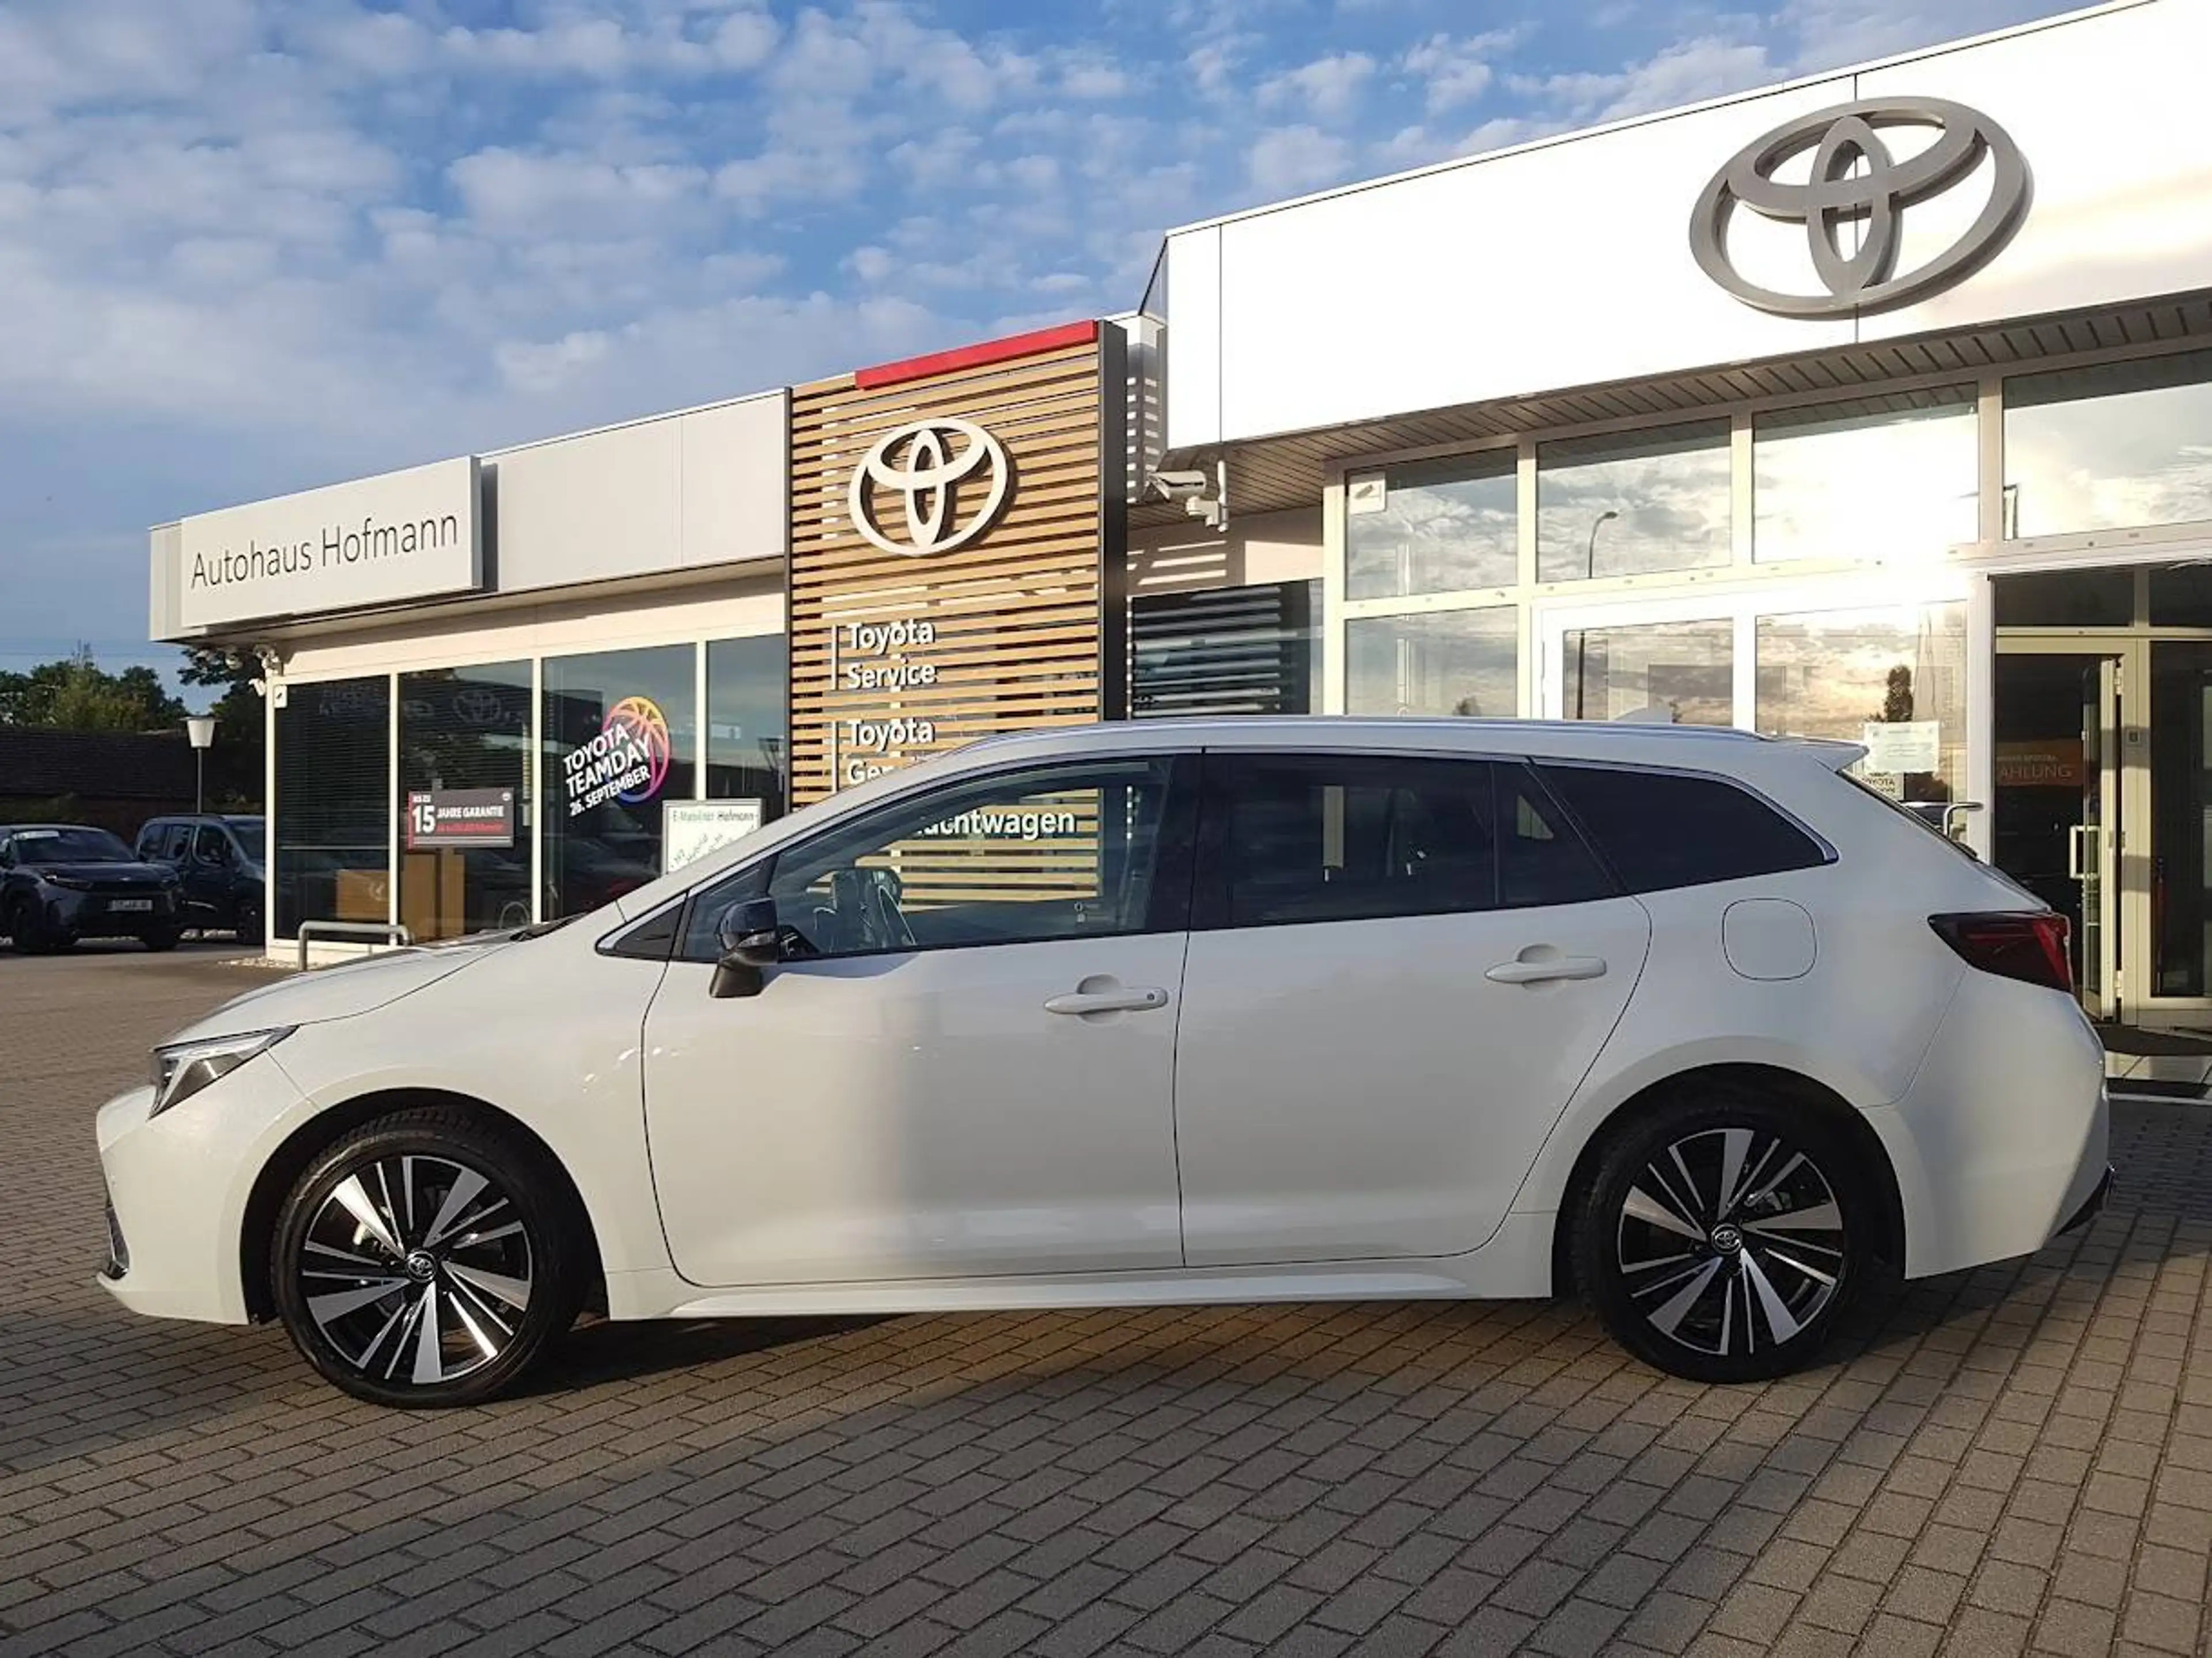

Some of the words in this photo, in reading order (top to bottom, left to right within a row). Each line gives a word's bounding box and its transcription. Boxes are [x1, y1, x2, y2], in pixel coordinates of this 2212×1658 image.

[191, 540, 312, 589] Autohaus
[323, 515, 457, 566] Hofmann
[847, 619, 934, 654] Toyota
[847, 658, 935, 688] Service
[563, 723, 630, 775] TOYOTA
[847, 718, 934, 752] Toyota
[566, 733, 650, 798] TEAMDAY
[585, 765, 650, 808] SEPTEMBER
[412, 806, 436, 833] 15
[436, 807, 461, 818] JAHRE
[463, 806, 504, 818] GARANTIE
